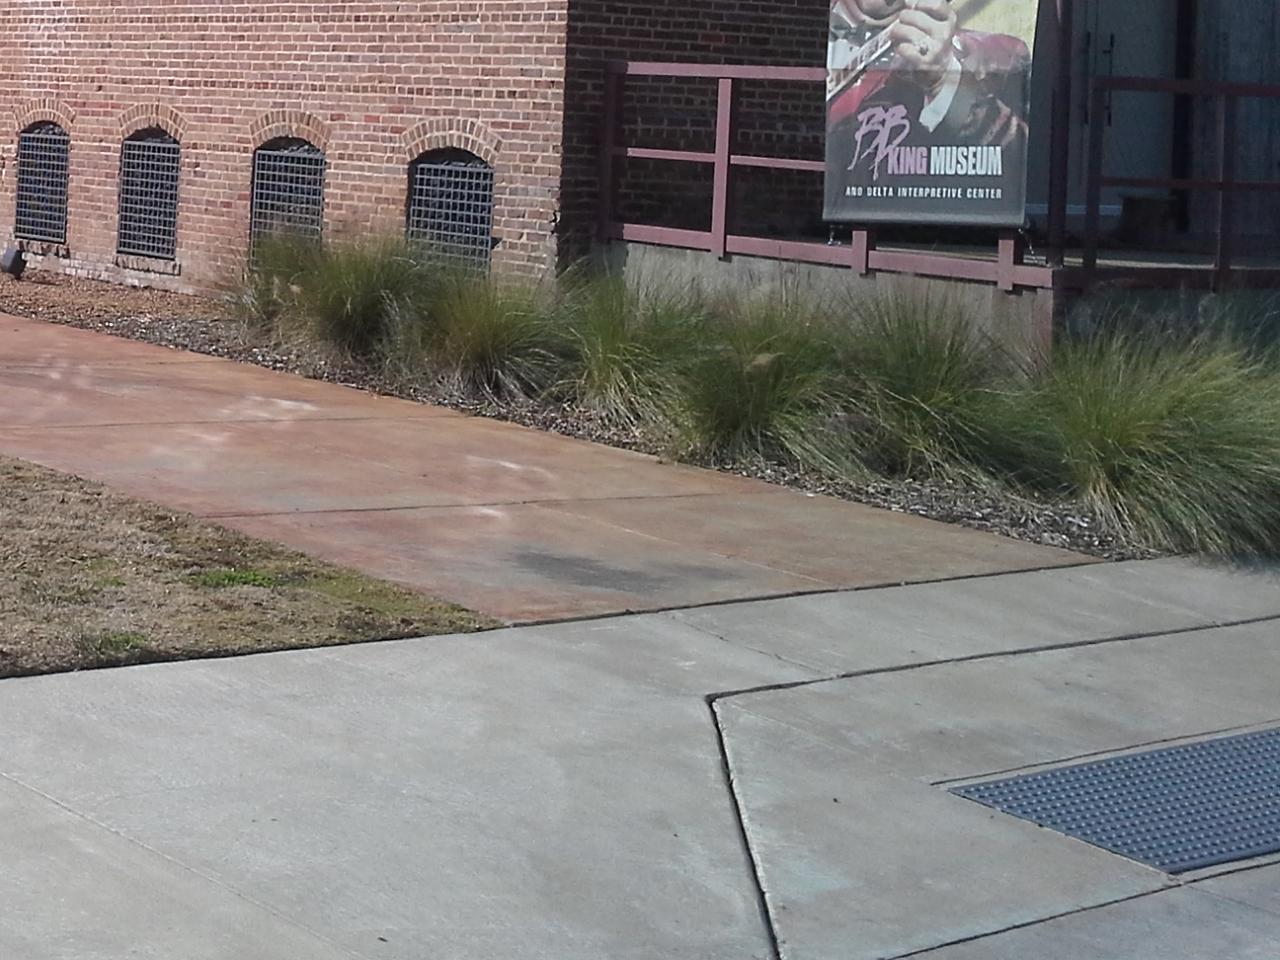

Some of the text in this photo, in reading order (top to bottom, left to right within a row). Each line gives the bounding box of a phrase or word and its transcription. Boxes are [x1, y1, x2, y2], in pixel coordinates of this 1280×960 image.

[888, 146, 928, 175] KING
[930, 146, 1002, 176] MUSEUM
[845, 186, 1002, 199] AND DELTA INTERPRETIVE CENTER
